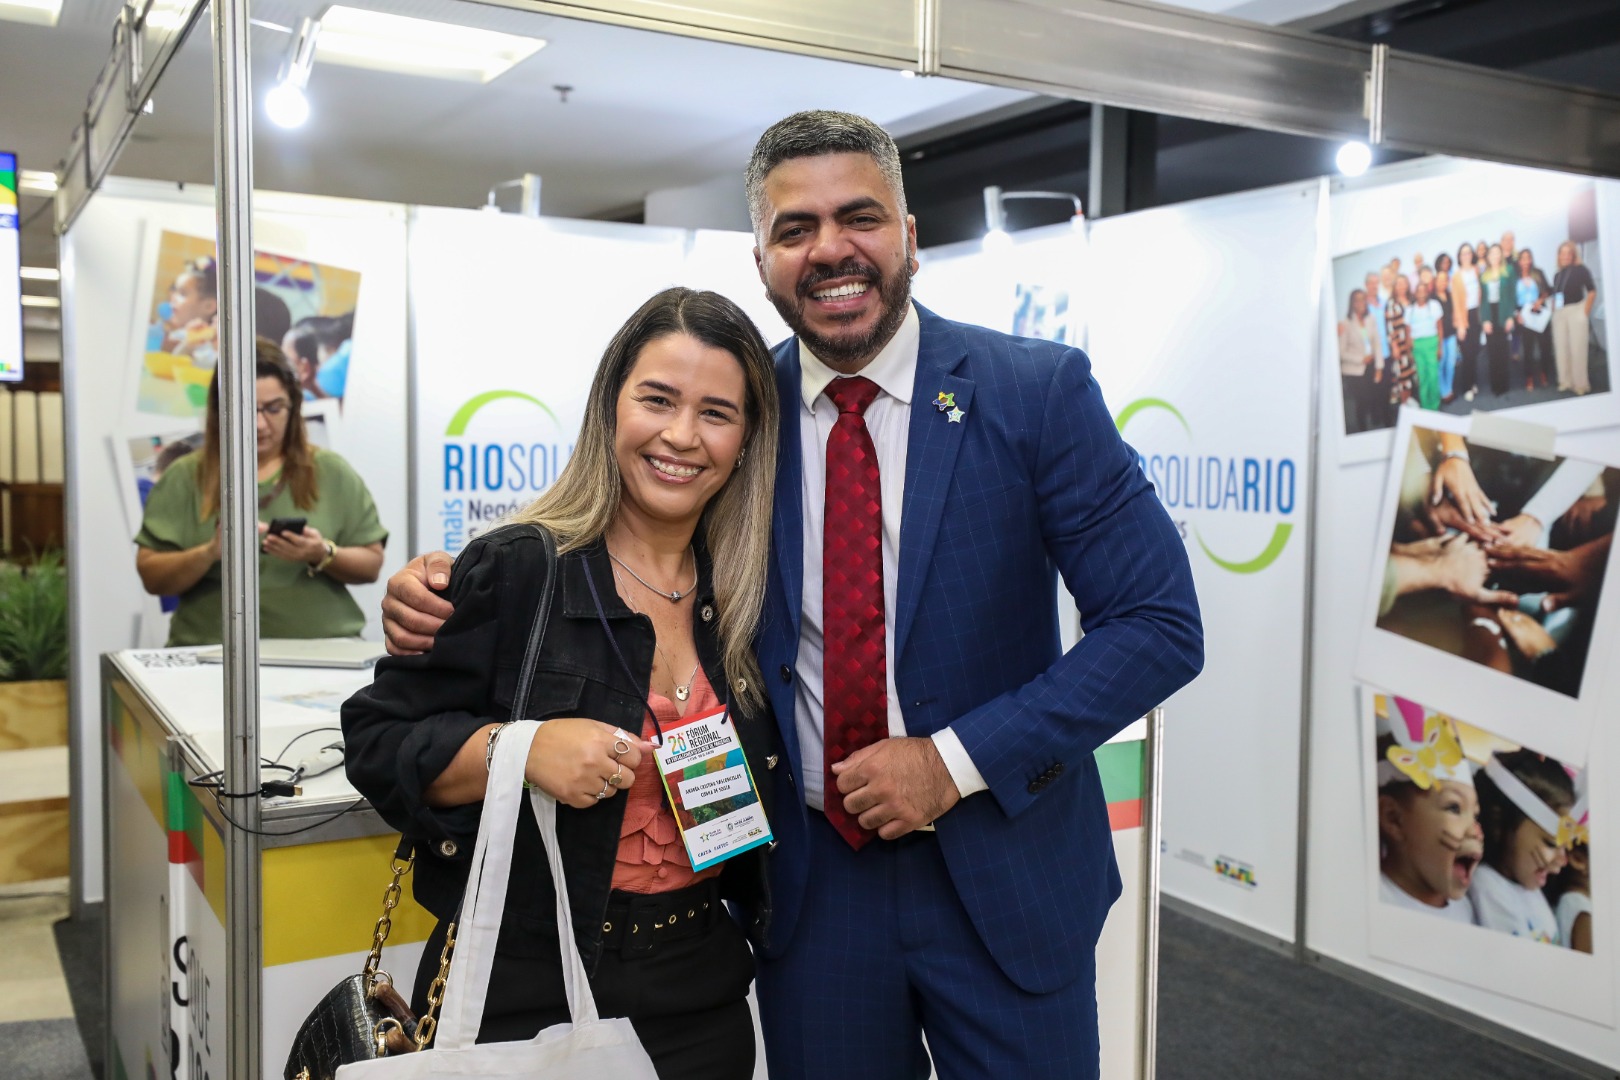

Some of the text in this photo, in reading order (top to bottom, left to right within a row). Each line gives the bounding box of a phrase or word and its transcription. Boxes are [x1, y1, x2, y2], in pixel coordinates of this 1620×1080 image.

[439, 498, 463, 551] mais
[686, 724, 709, 739] FÓRUM
[689, 730, 721, 748] REGIONAL
